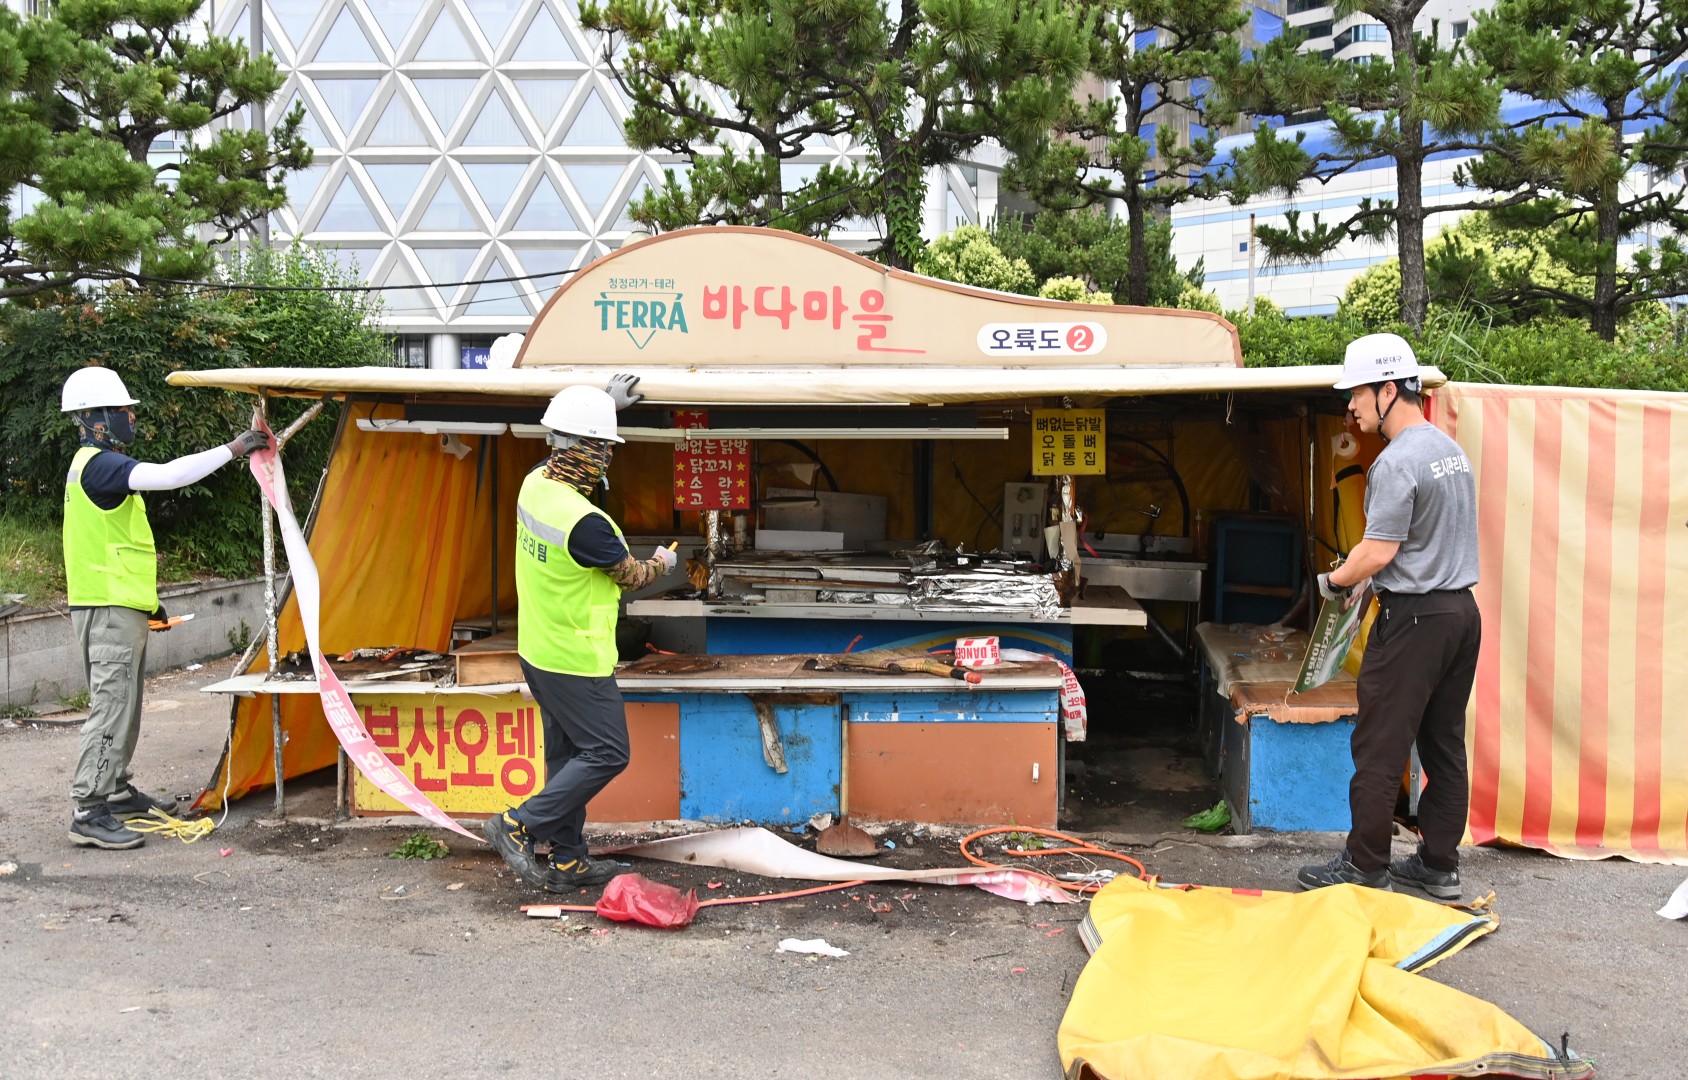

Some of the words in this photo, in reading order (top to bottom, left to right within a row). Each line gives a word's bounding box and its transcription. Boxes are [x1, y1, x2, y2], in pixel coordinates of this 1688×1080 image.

[608, 277, 675, 289] 청정라거-테라
[702, 284, 927, 354] 바다마을
[990, 328, 1061, 351] 오륙도
[1073, 328, 1087, 349] 2
[1375, 355, 1402, 365] 해운대구
[690, 458, 733, 474] 닭꼬지
[365, 705, 536, 796] 부산오뎅
